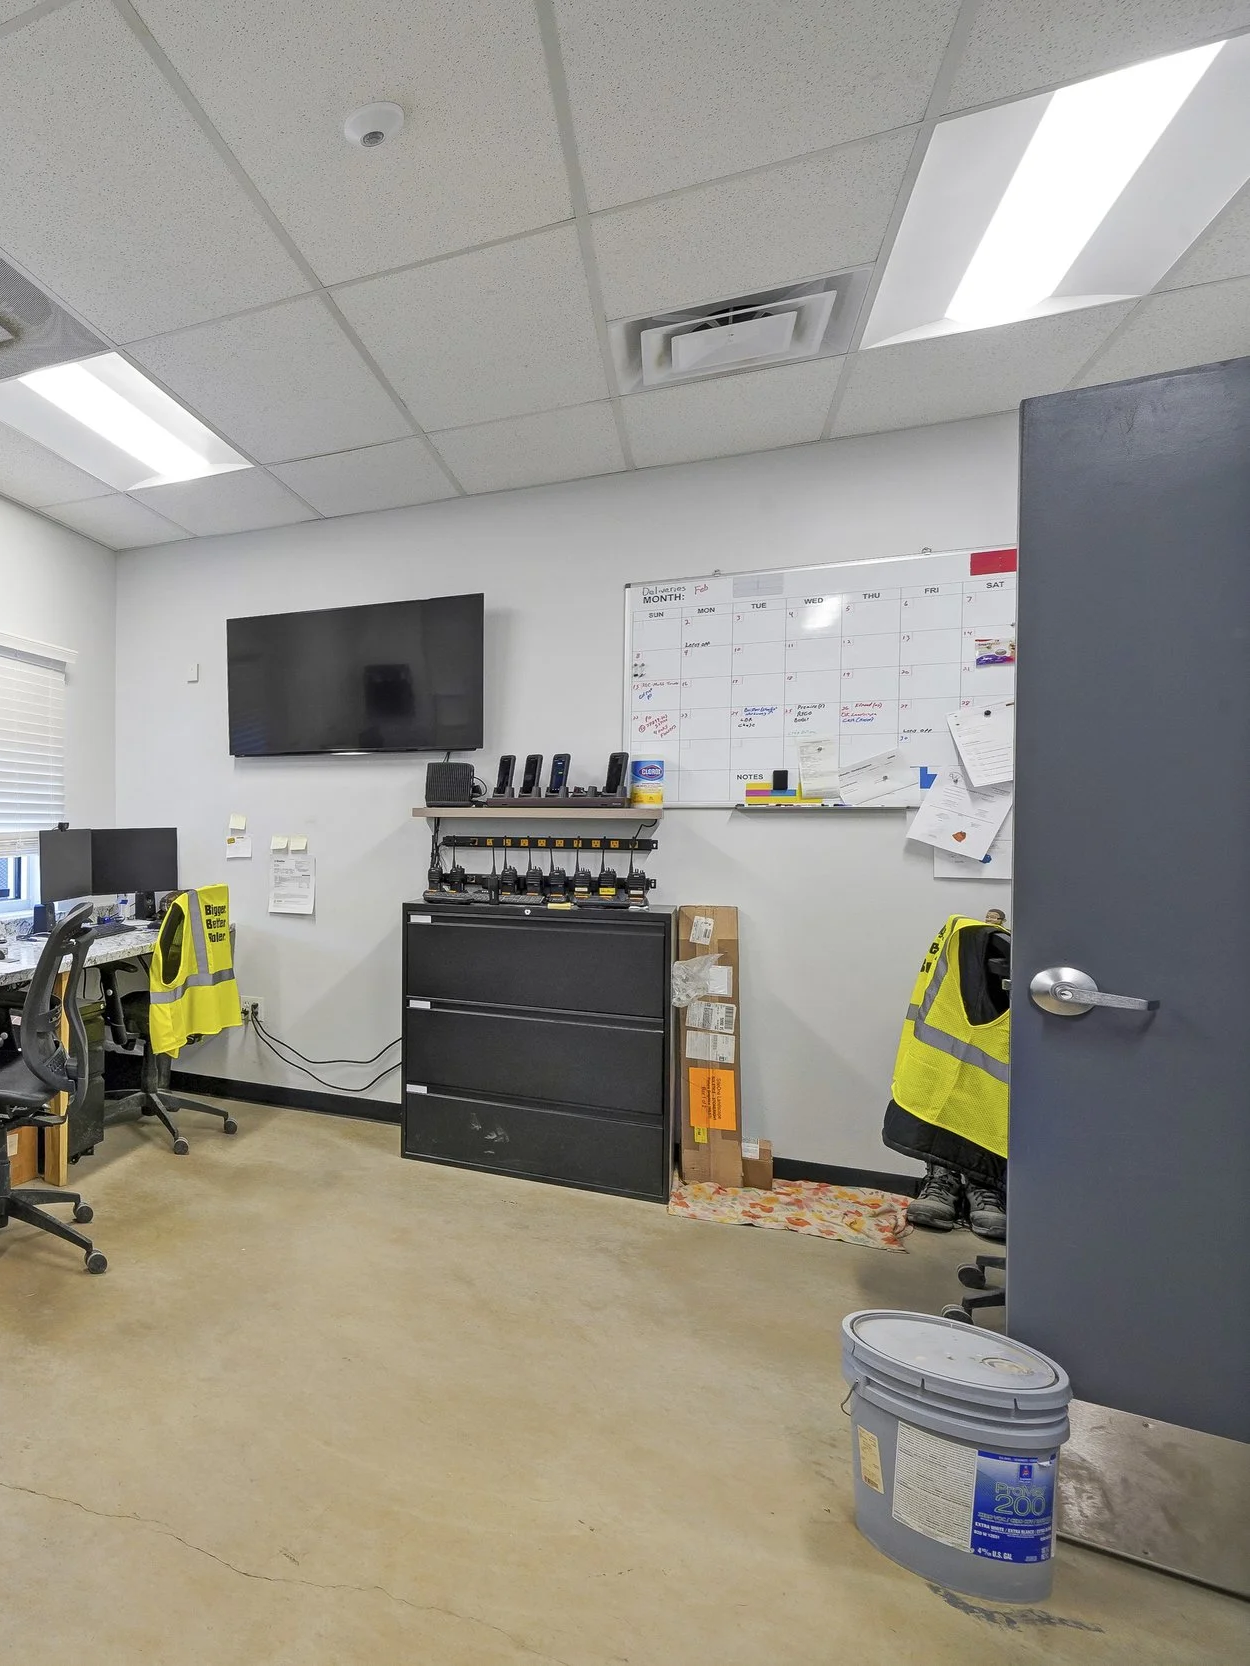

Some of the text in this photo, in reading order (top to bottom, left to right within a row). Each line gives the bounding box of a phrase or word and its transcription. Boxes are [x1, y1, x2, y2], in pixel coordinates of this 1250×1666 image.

[643, 593, 685, 604] MONTH:
[803, 597, 824, 605] WED
[994, 1493, 1046, 1517] 200
